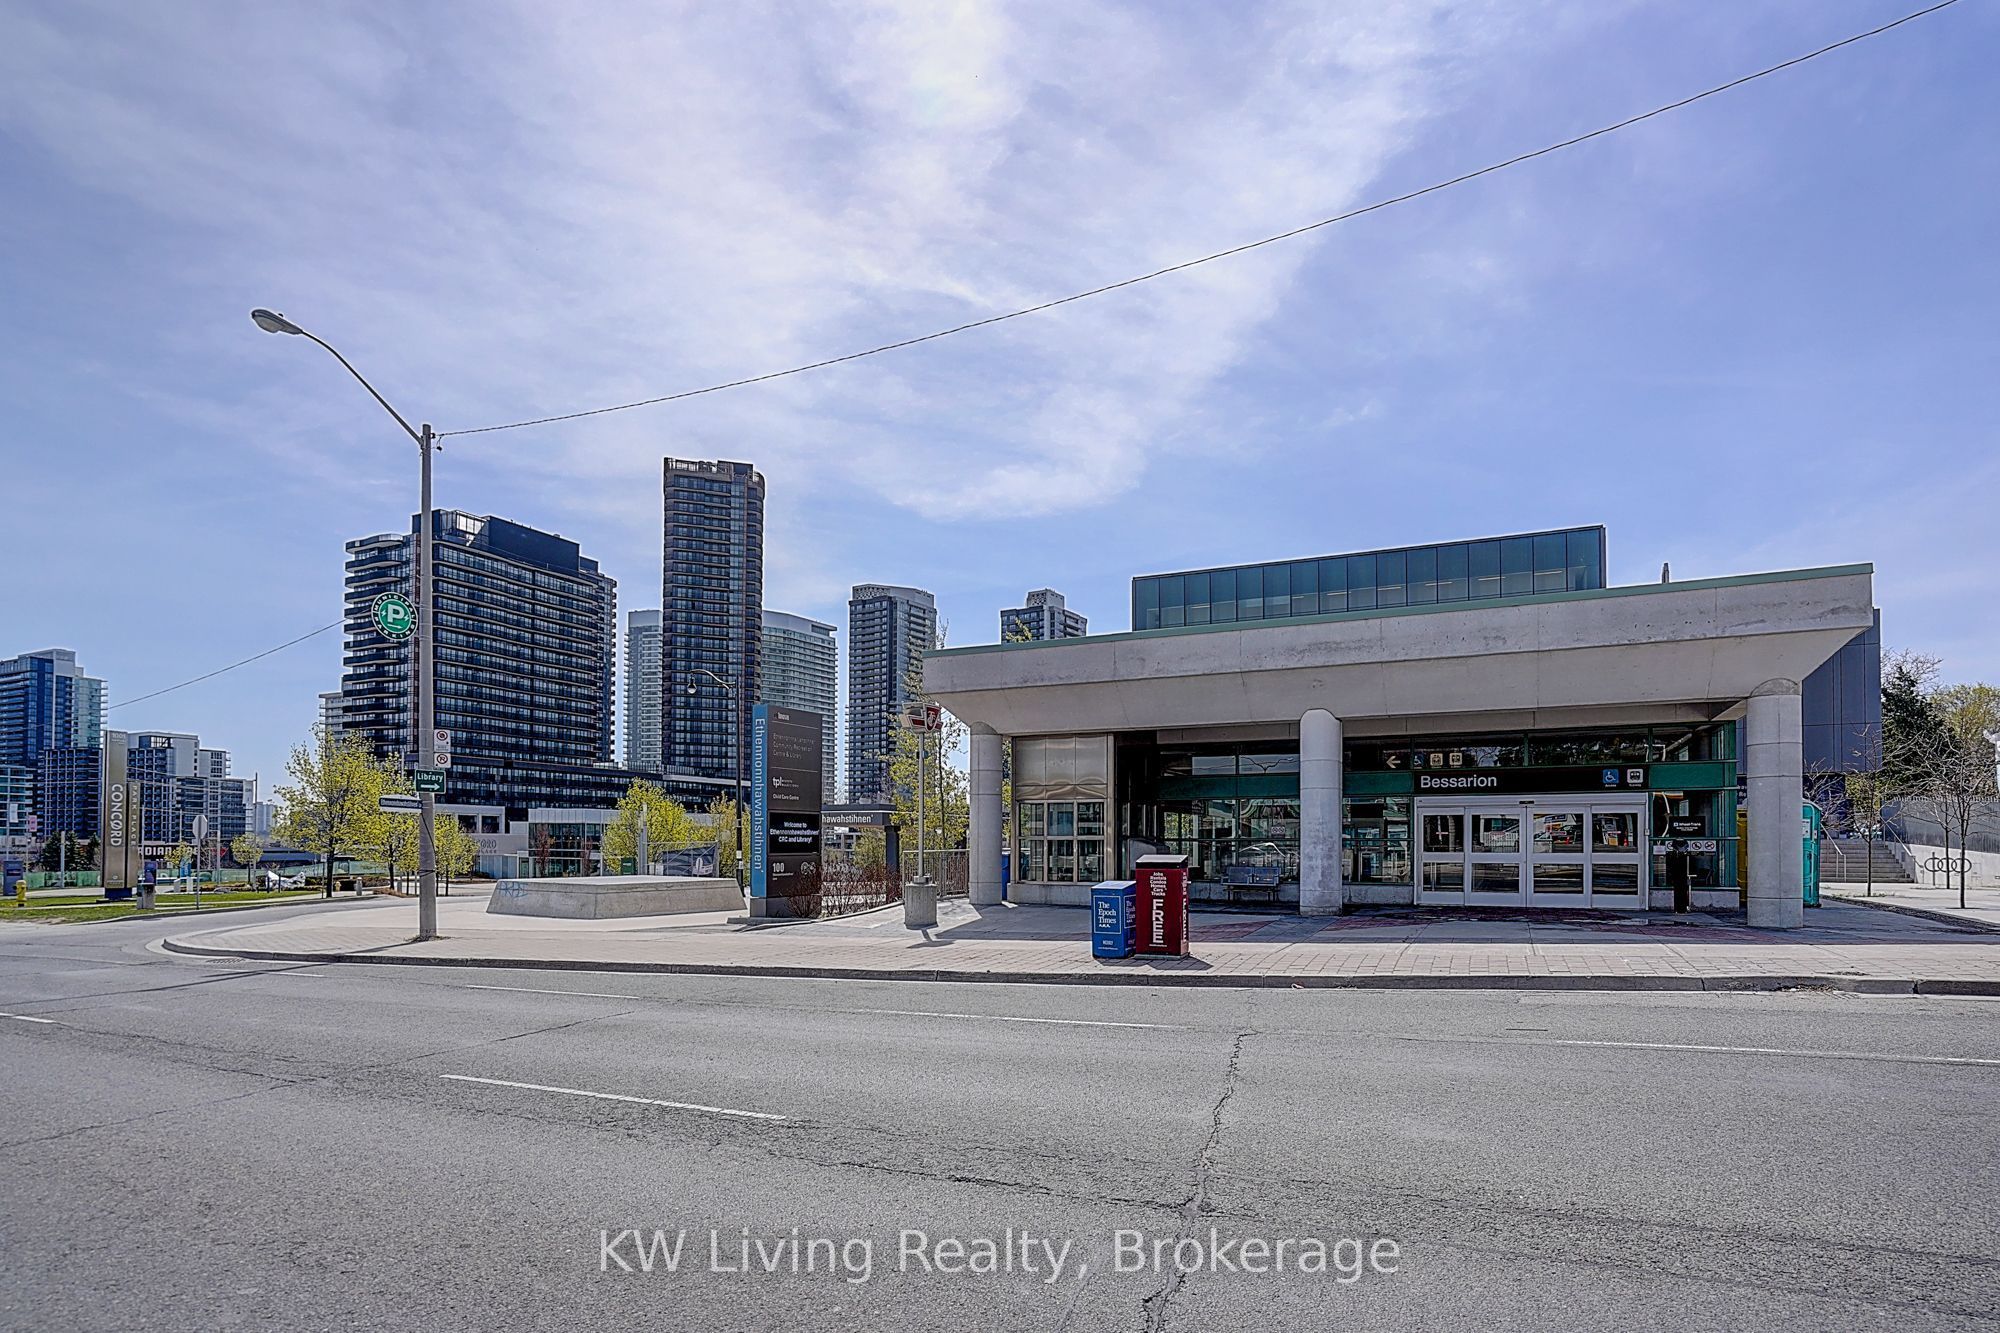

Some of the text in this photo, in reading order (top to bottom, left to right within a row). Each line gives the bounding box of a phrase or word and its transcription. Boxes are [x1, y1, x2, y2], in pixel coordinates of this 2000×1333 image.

[387, 603, 405, 623] P
[417, 772, 444, 783] Library
[1420, 774, 1497, 788] Bessarion
[772, 862, 785, 872] 100
[1098, 901, 1110, 909] The
[1098, 908, 1117, 917] Epoch
[1098, 916, 1117, 924] Times
[1152, 898, 1164, 943] FREE
